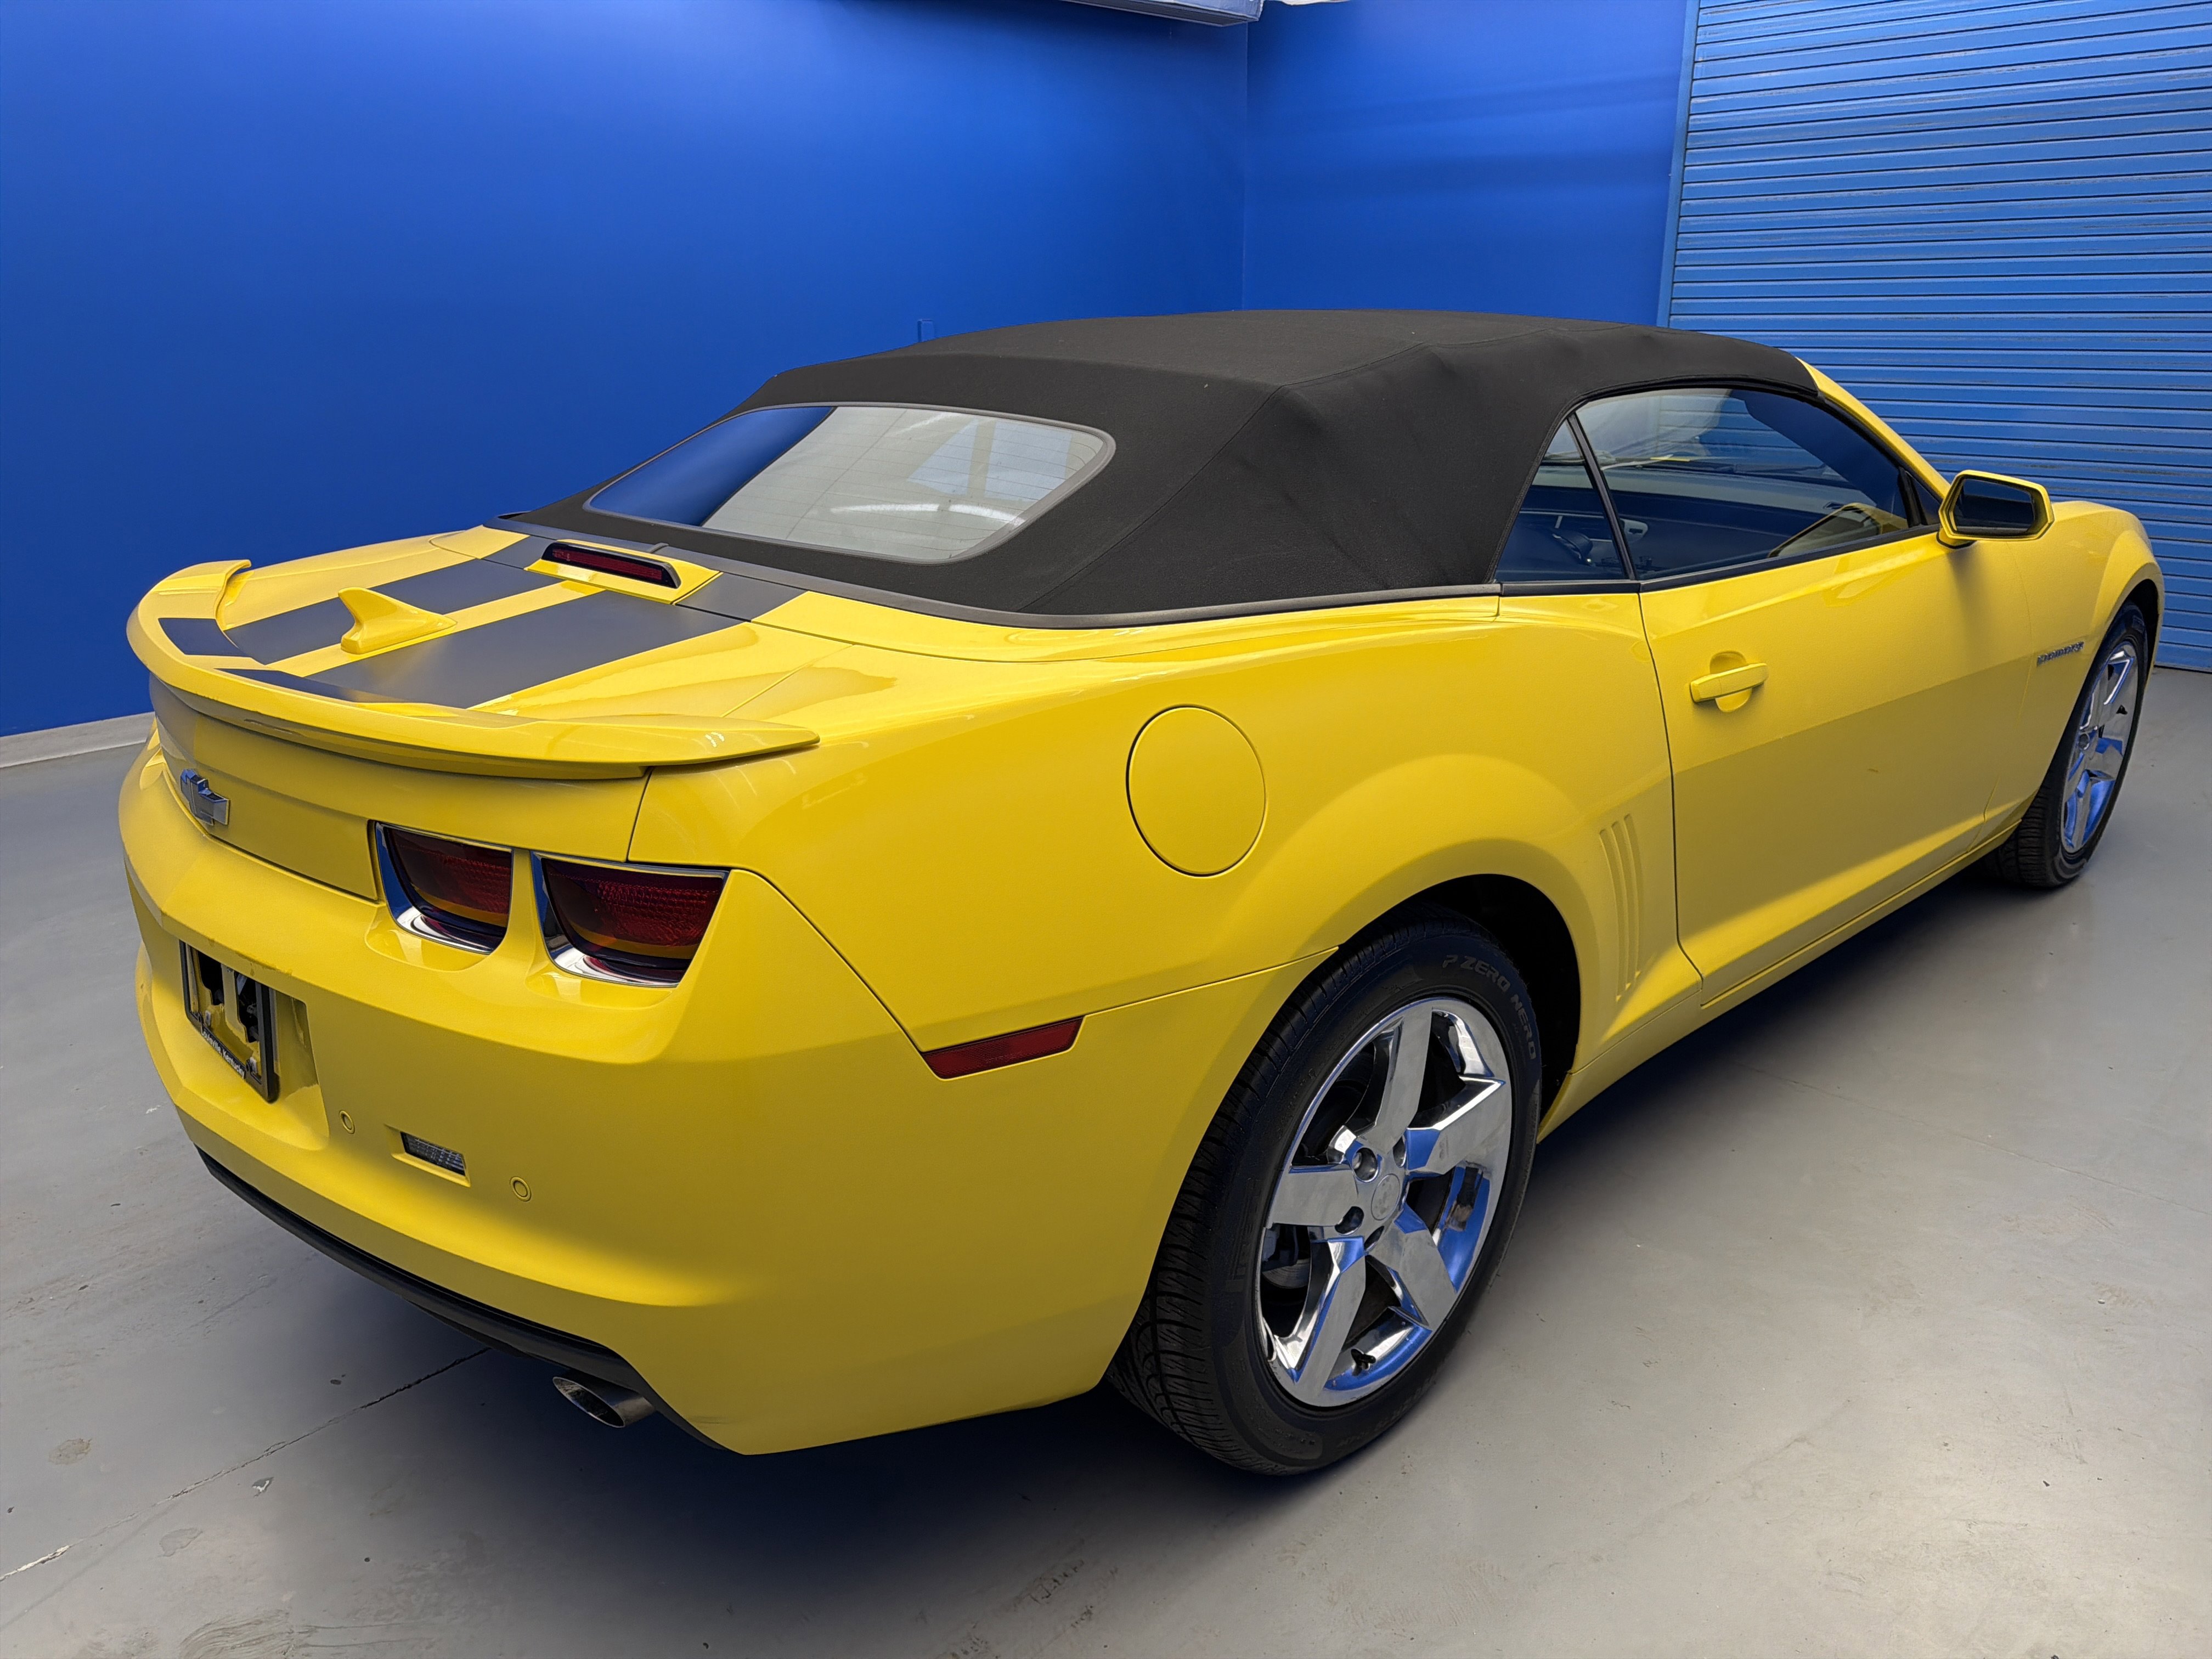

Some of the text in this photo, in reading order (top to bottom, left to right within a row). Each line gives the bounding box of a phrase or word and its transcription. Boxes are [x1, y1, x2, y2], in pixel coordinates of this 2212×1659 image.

[1460, 955, 1511, 992] ZERO
[1510, 994, 1536, 1060] NERO
[222, 1048, 245, 1080] Kentucky
